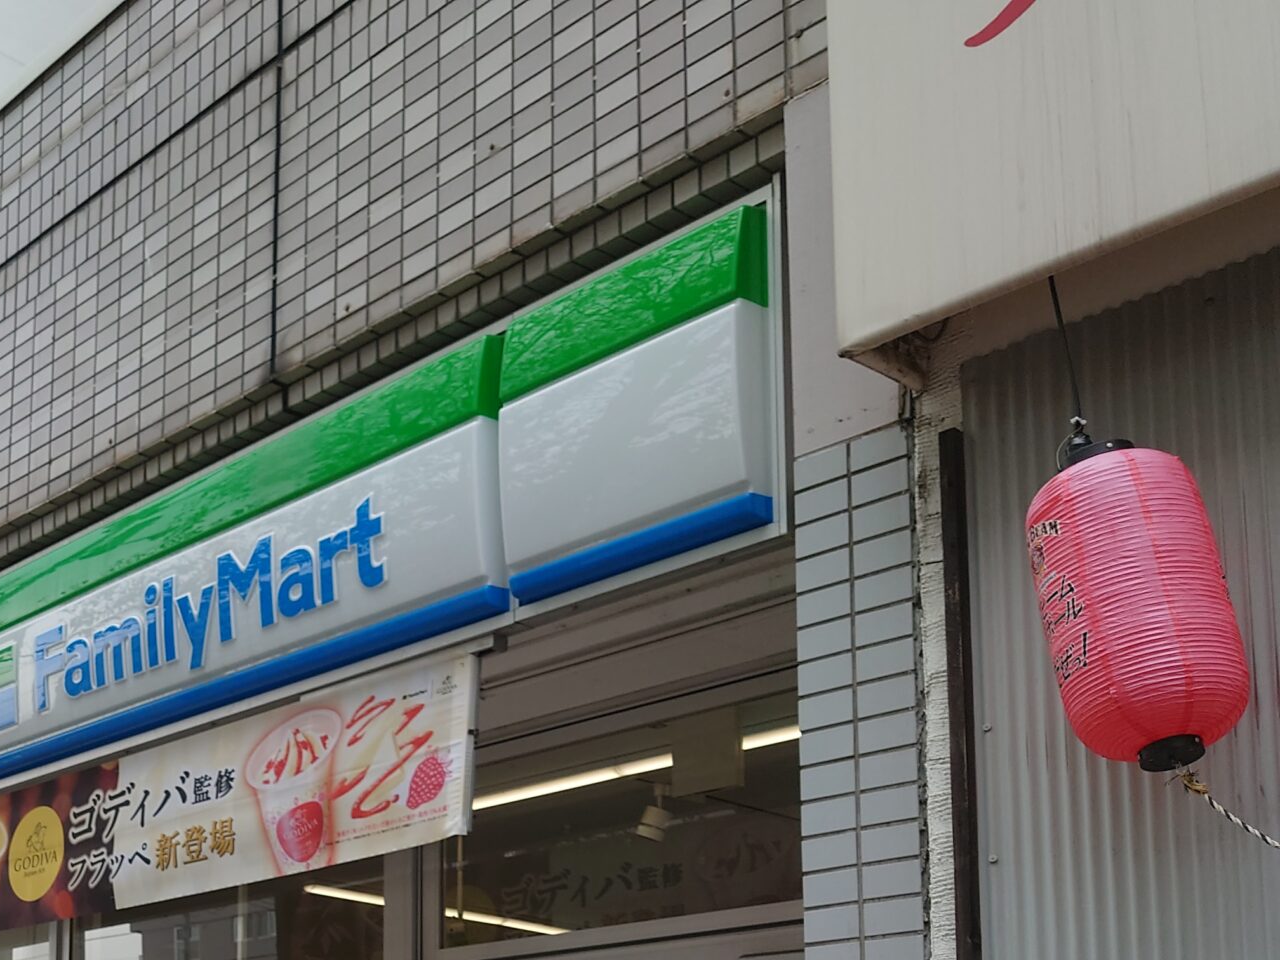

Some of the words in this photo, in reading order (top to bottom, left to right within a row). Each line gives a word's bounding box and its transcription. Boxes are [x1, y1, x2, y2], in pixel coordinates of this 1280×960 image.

[33, 493, 389, 713] FamilyMart
[68, 767, 236, 843] ゴディバ監修
[14, 850, 59, 872] GODIVA
[67, 815, 236, 891] フラッペ新登場
